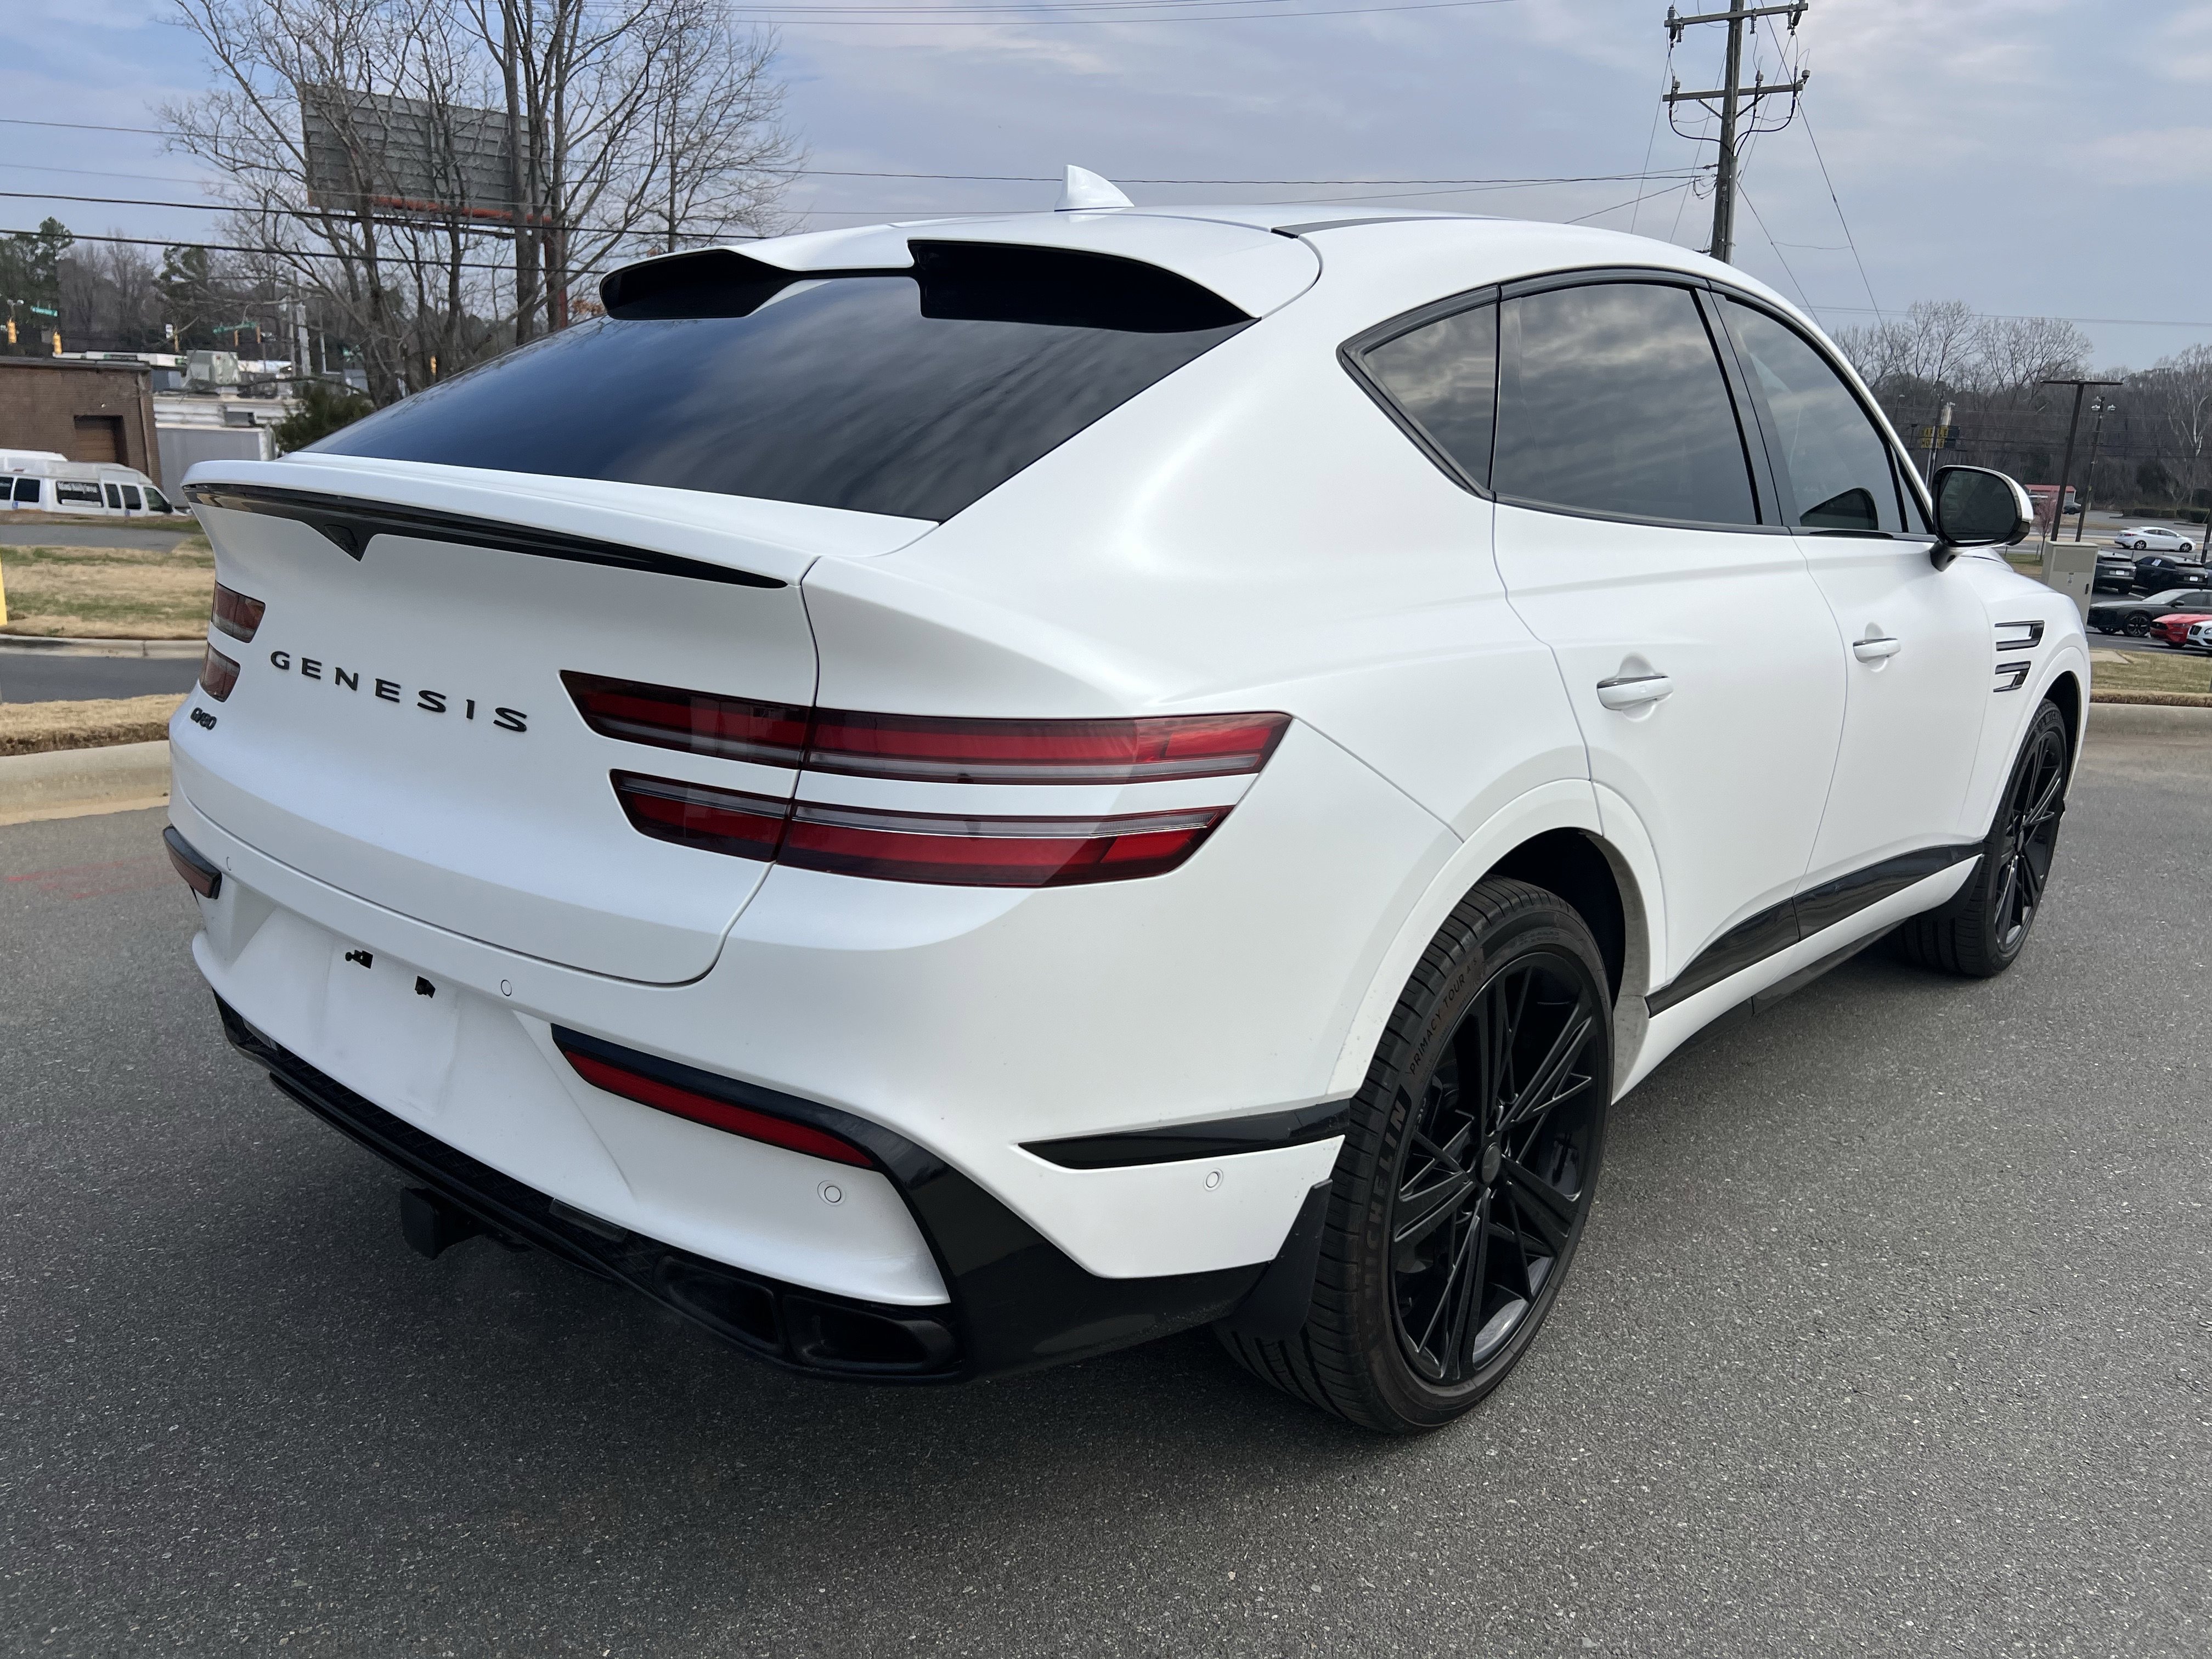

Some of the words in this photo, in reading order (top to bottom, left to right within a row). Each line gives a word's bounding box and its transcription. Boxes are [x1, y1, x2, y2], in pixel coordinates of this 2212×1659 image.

[190, 707, 217, 730] GV80
[270, 651, 527, 732] GENESIS
[1409, 1009, 1442, 1075] PRIMACY
[1443, 974, 1466, 1008] TOUR
[1364, 1099, 1406, 1300] MICHELIN
